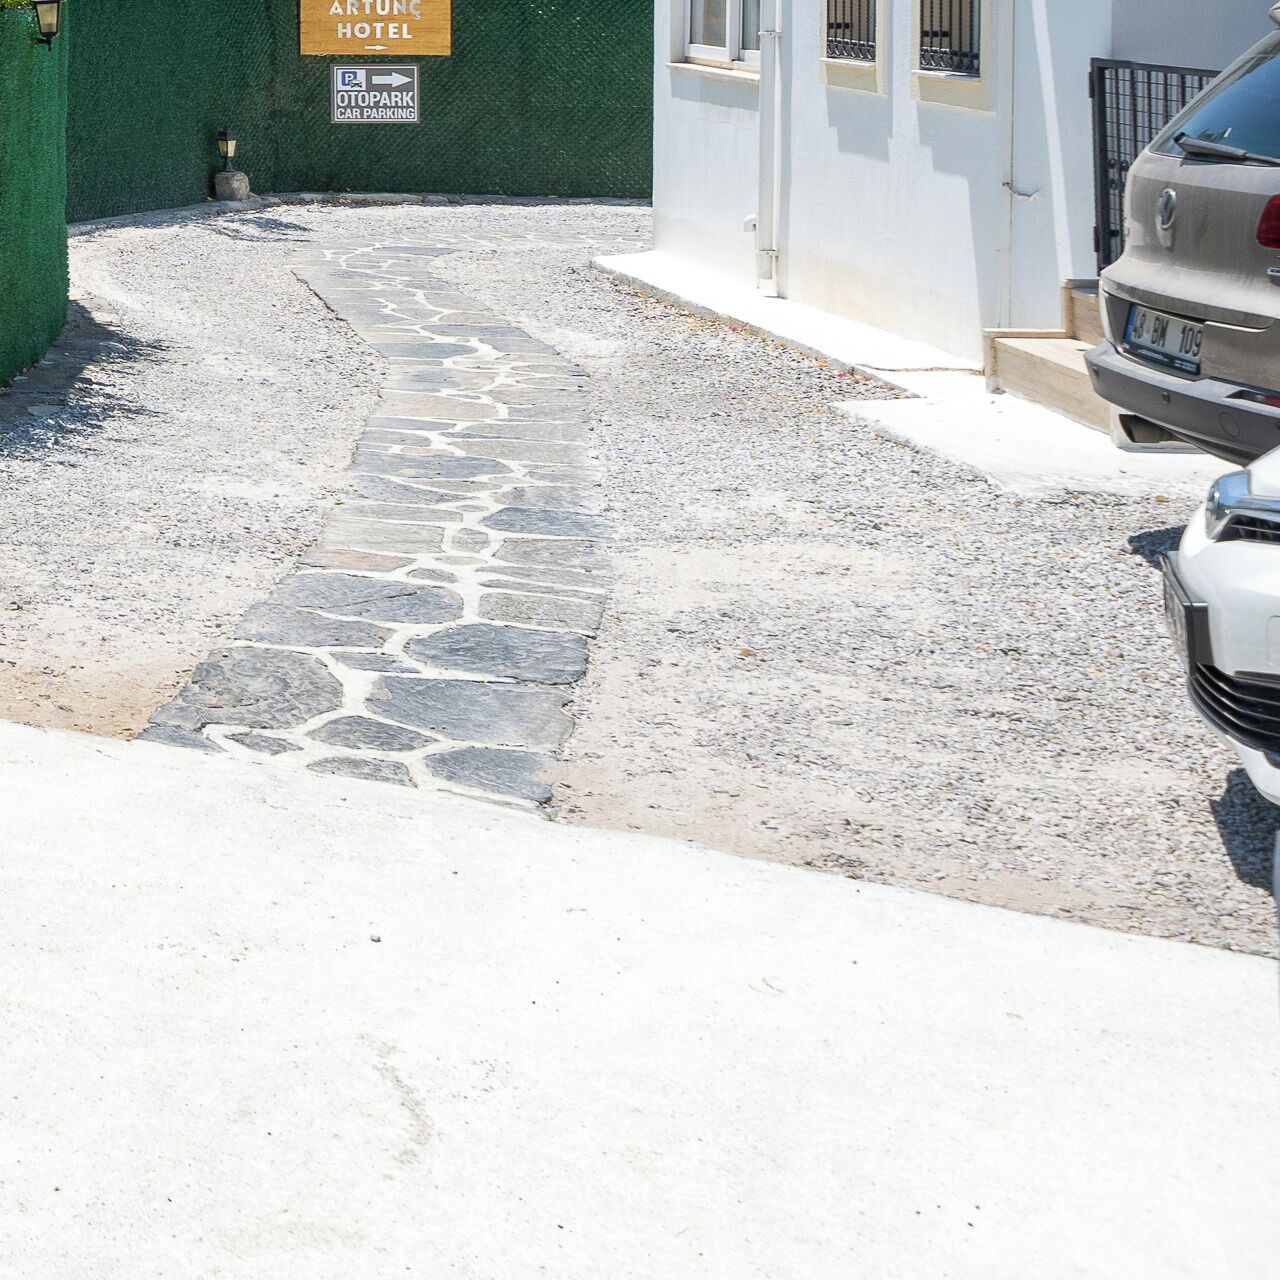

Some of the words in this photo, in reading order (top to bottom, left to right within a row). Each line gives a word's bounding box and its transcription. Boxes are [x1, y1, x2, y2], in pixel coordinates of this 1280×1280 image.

[337, 21, 413, 39] HOTEL
[337, 91, 415, 107] OTOPARK
[337, 108, 360, 119] CAR
[363, 108, 415, 119] PARKING
[1179, 325, 1202, 357] 109
